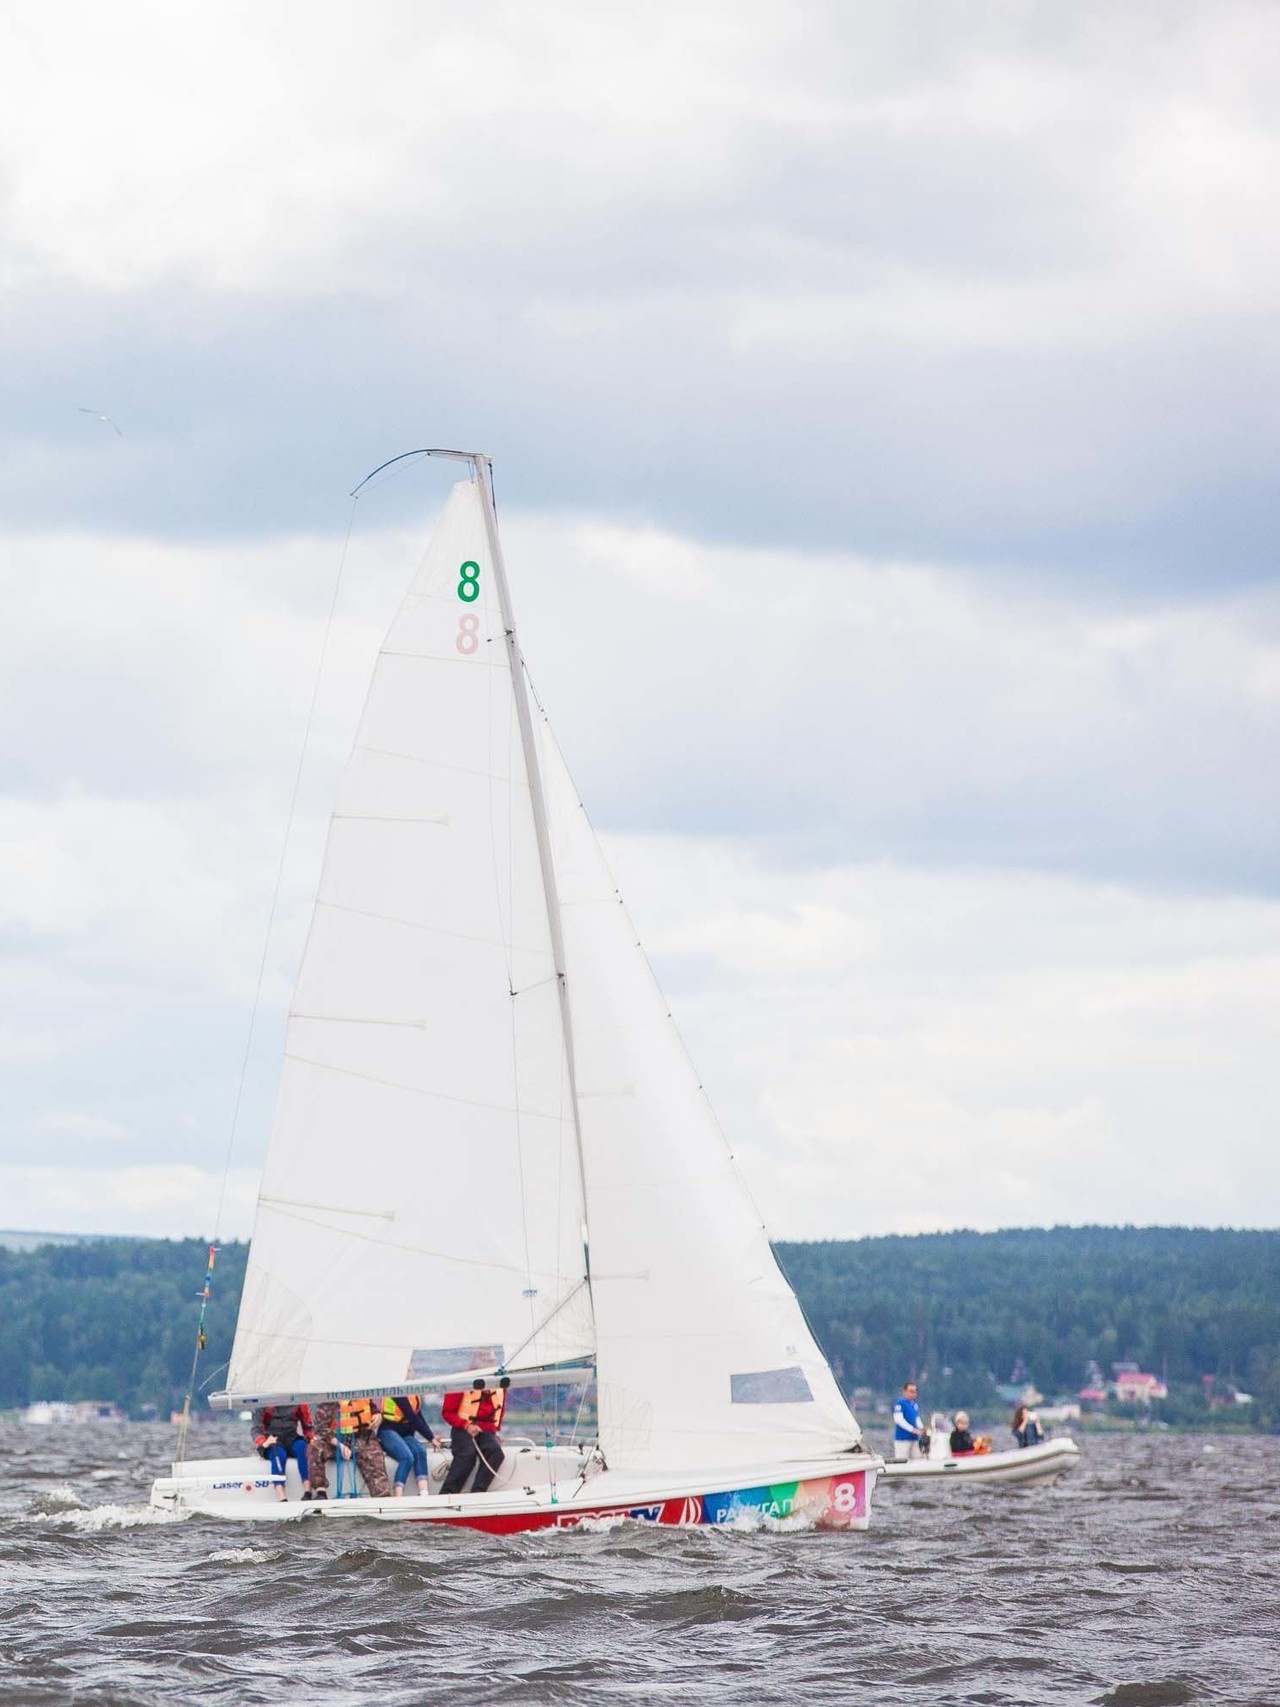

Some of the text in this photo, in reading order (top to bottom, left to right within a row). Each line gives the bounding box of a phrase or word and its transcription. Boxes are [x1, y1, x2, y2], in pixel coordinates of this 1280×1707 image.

[457, 560, 480, 603] 8
[456, 613, 480, 655] 8
[834, 1482, 856, 1513] 8
